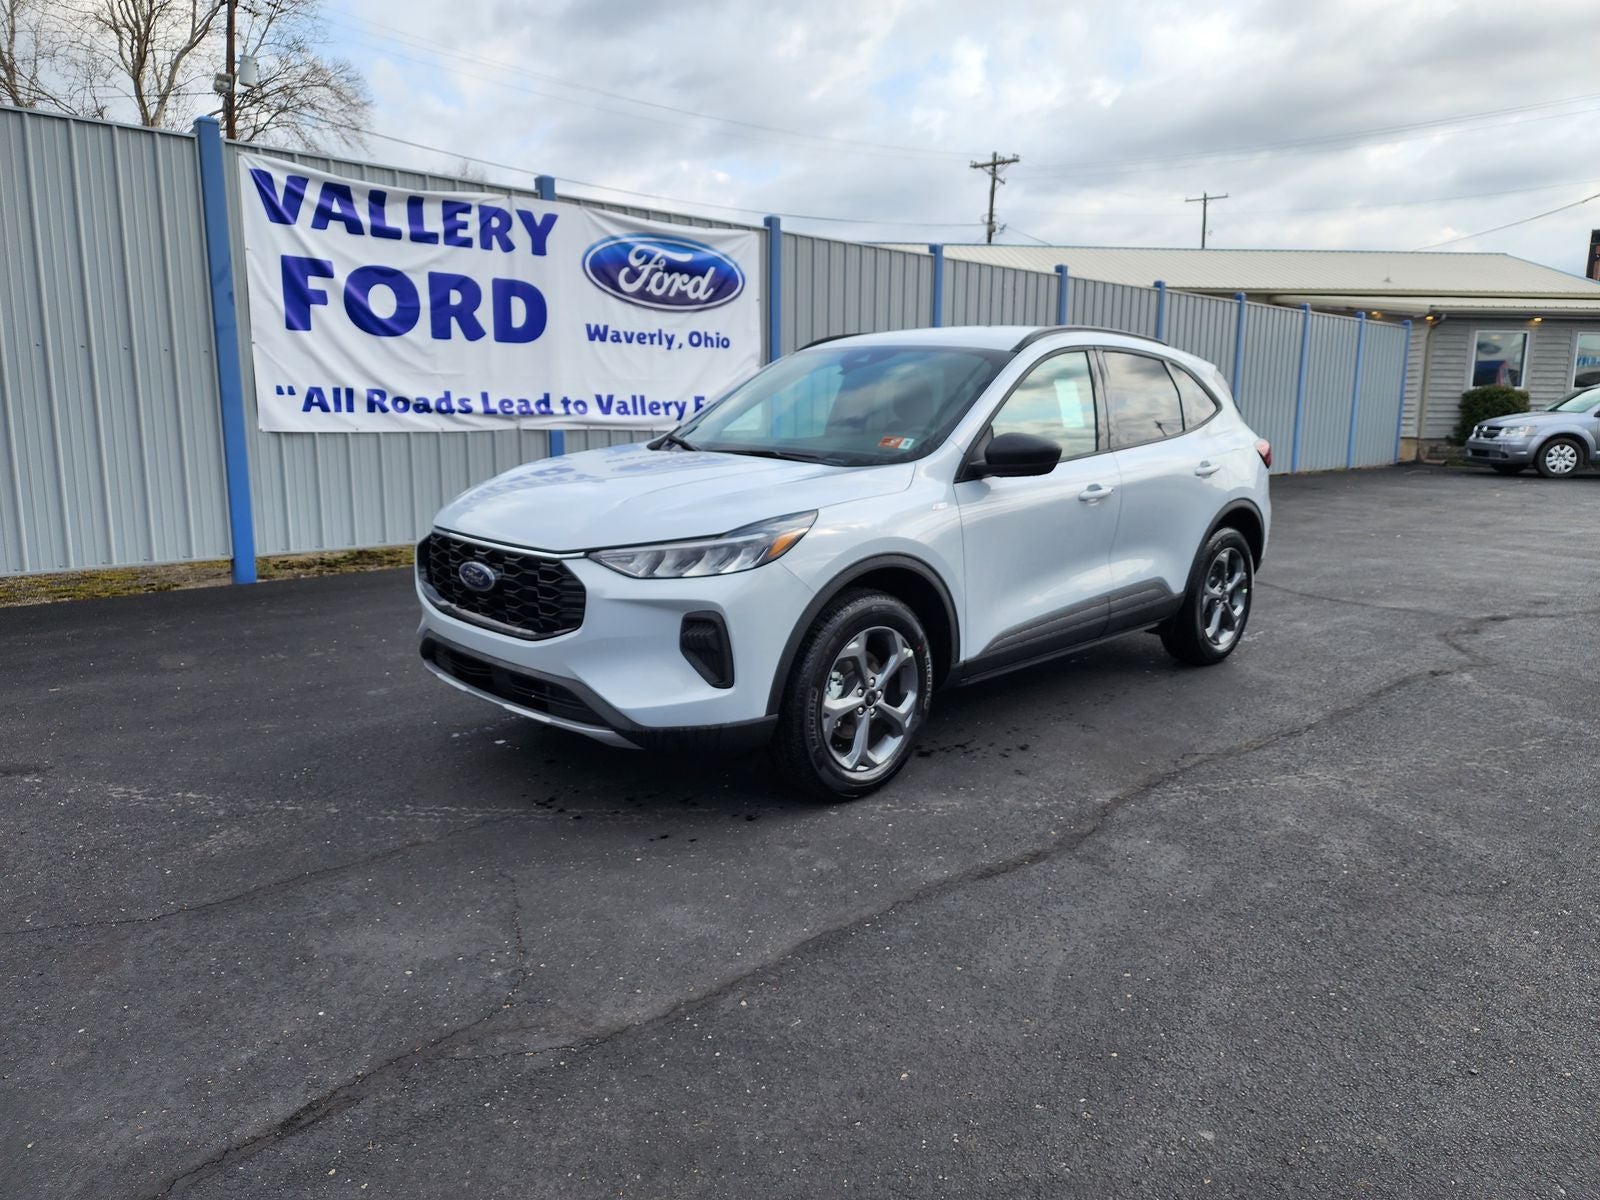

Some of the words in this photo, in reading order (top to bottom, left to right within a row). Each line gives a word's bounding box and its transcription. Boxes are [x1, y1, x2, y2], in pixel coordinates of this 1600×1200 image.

[249, 168, 558, 256] VALLERY
[281, 254, 547, 344] FORD
[618, 244, 716, 301] Ford
[688, 331, 731, 349] Ohio
[366, 388, 473, 415] Roads
[480, 391, 553, 415] Lead
[561, 396, 588, 415] to
[595, 394, 687, 421] Vallery
